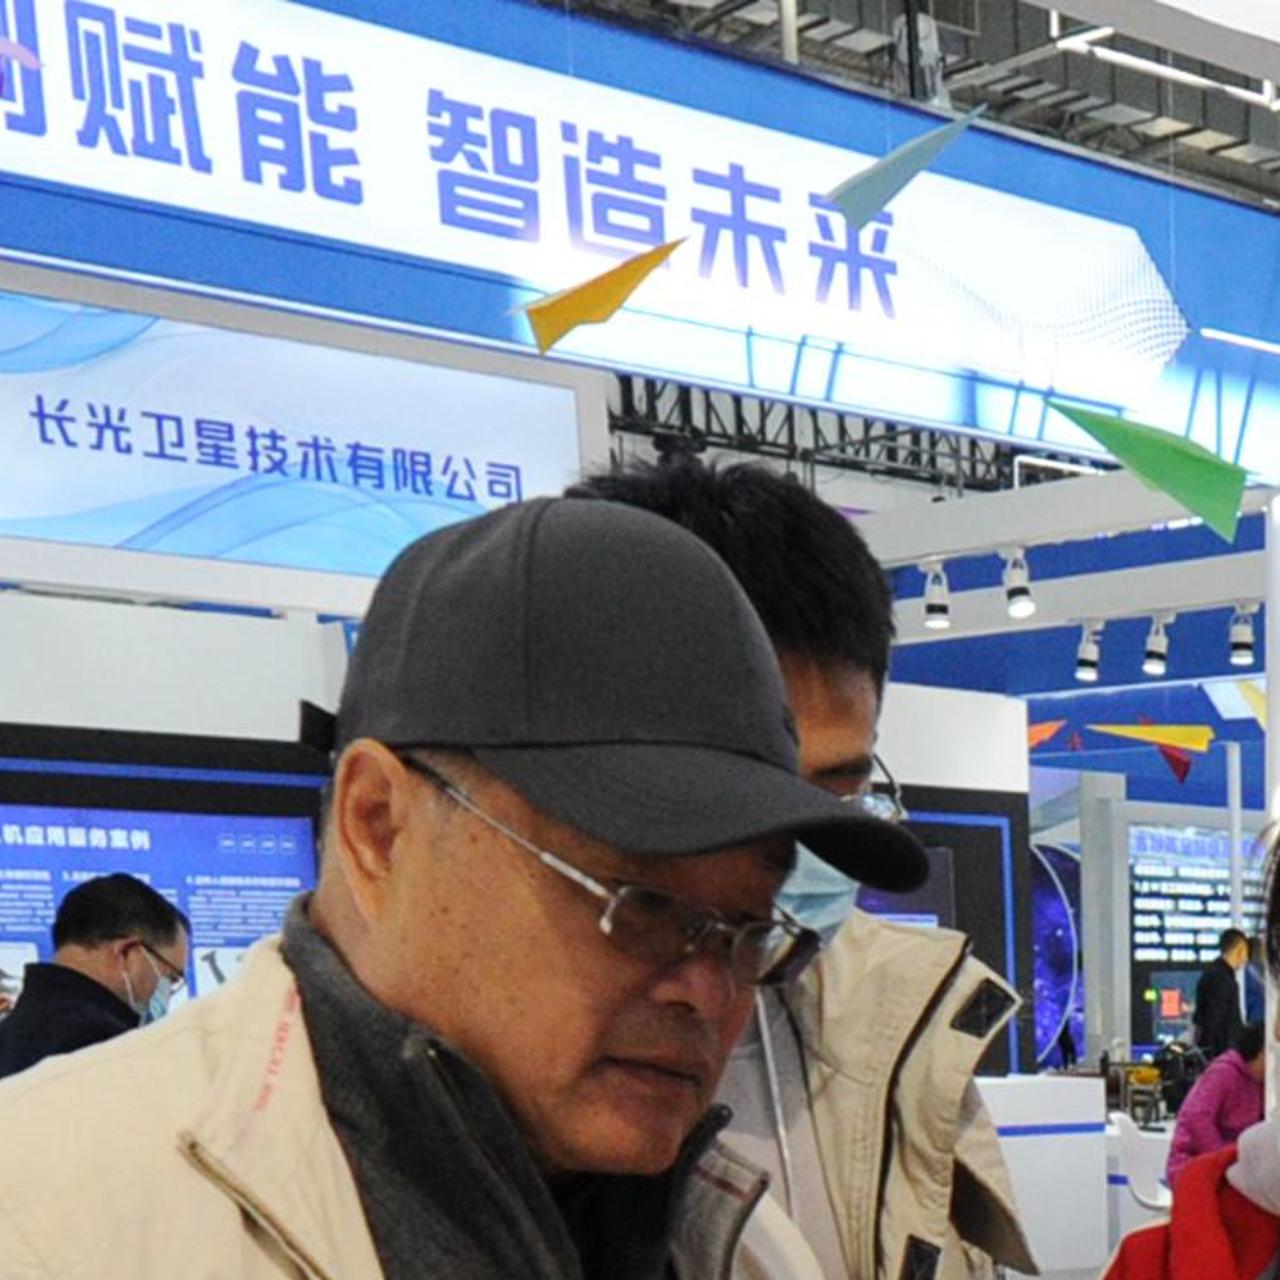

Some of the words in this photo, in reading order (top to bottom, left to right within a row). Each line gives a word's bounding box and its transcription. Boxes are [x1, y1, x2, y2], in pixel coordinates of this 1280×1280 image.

[427, 89, 897, 318] 智造未来
[29, 395, 522, 504] 长光卫星技术有限公司
